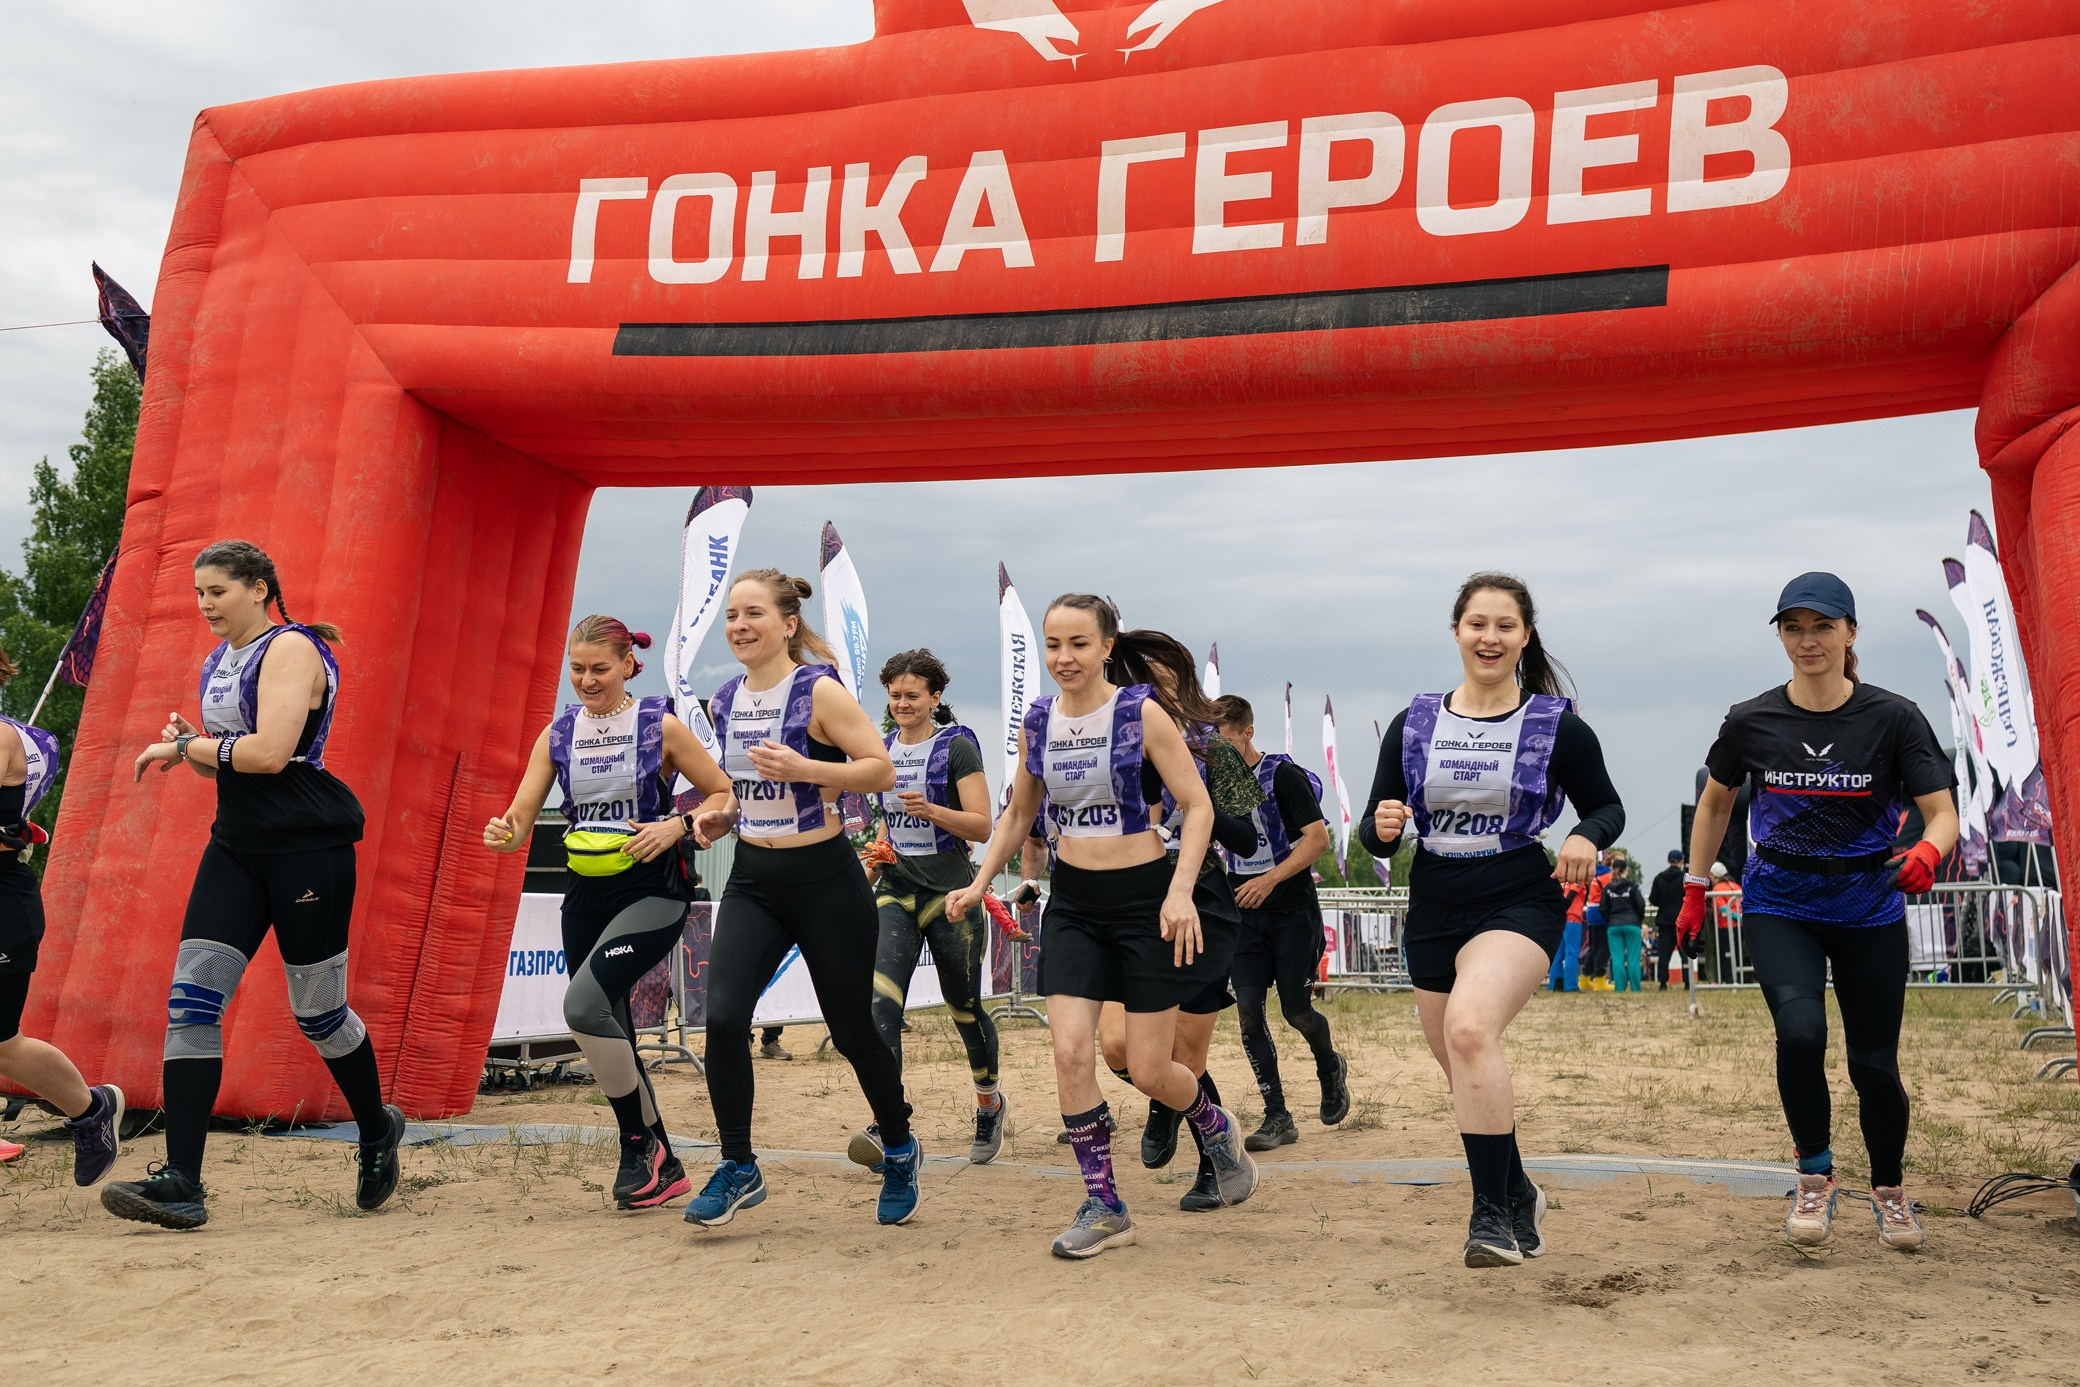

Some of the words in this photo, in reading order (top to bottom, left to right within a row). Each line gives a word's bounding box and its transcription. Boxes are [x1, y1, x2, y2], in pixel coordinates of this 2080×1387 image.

[566, 149, 1036, 285] ГОНКА
[1093, 63, 1793, 263] ГЕРОЕВ
[1006, 632, 1026, 756] СЕНЕЖСКАЯ
[731, 709, 754, 718] ГОНКА
[755, 708, 781, 717] ГЕРОЕВ
[733, 728, 771, 740] КОМАНДНЫЙ
[574, 738, 600, 747] ГОНКА
[602, 735, 634, 744] ГЕРОЕВ
[742, 740, 760, 749] СТАРТ
[1048, 738, 1074, 748] ГОНКА
[1076, 736, 1108, 746] ГЕРОЕВ
[1435, 740, 1469, 749] ГОНКА
[1472, 742, 1512, 750] ГЕРОЕВ
[580, 751, 625, 766] КОМАНДНЫЙ
[1052, 756, 1098, 772] КОМАНДНЫЙ
[591, 764, 613, 774] СТАРТ
[1439, 760, 1500, 772] КОМАНДНЫЙ
[1065, 771, 1086, 781] СТАРТ
[1453, 771, 1482, 781] СТАРТ
[1764, 770, 1873, 788] ИНСТРУКТОР
[579, 799, 635, 821] 07201
[750, 817, 795, 827] ГАЗПРОМБАНК
[1432, 809, 1505, 836] 07208
[605, 945, 634, 958] HOKA
[509, 950, 570, 976] ГАЗПРО
[1090, 1143, 1110, 1153] Секц
